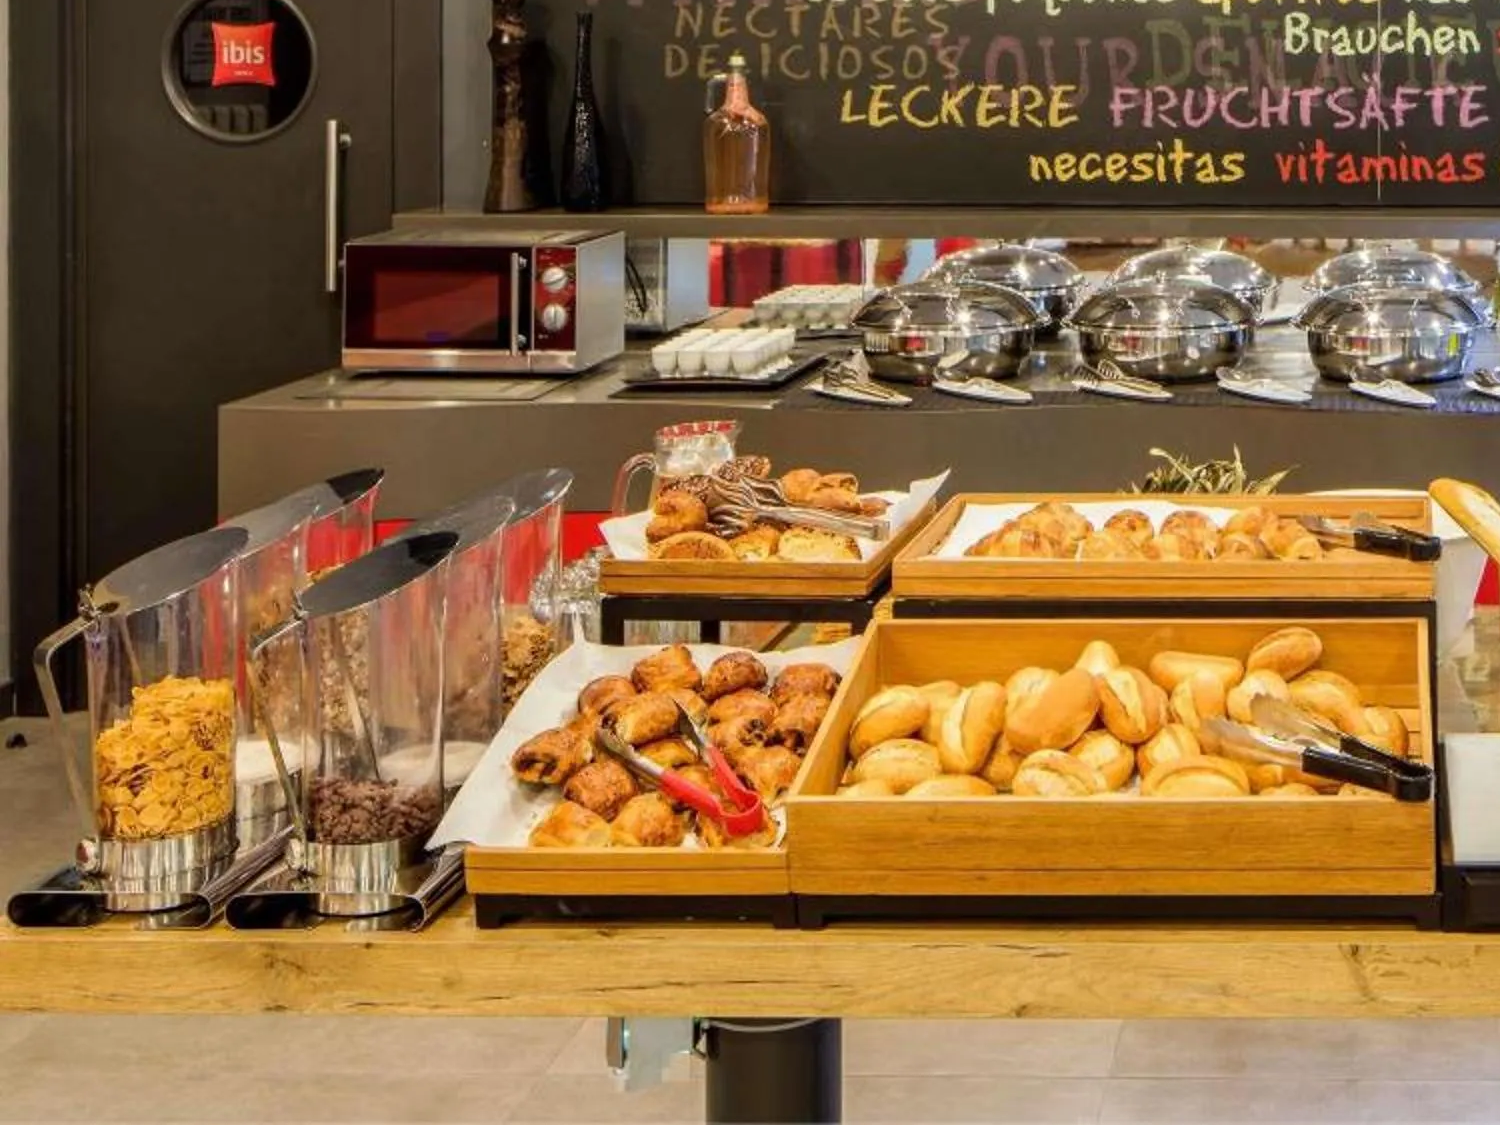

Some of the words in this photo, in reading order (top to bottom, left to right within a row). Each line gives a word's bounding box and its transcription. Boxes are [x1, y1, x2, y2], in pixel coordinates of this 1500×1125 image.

[674, 3, 950, 40] NECTARES
[1283, 11, 1481, 56] Brauchen
[223, 40, 265, 64] ibis
[664, 43, 960, 80] DEICIOSOS
[840, 84, 1078, 128] LECKERE
[1110, 72, 1490, 130] FRUCHTSÄFTE
[1029, 138, 1245, 183] necesitas
[1274, 139, 1486, 184] vitaminas
